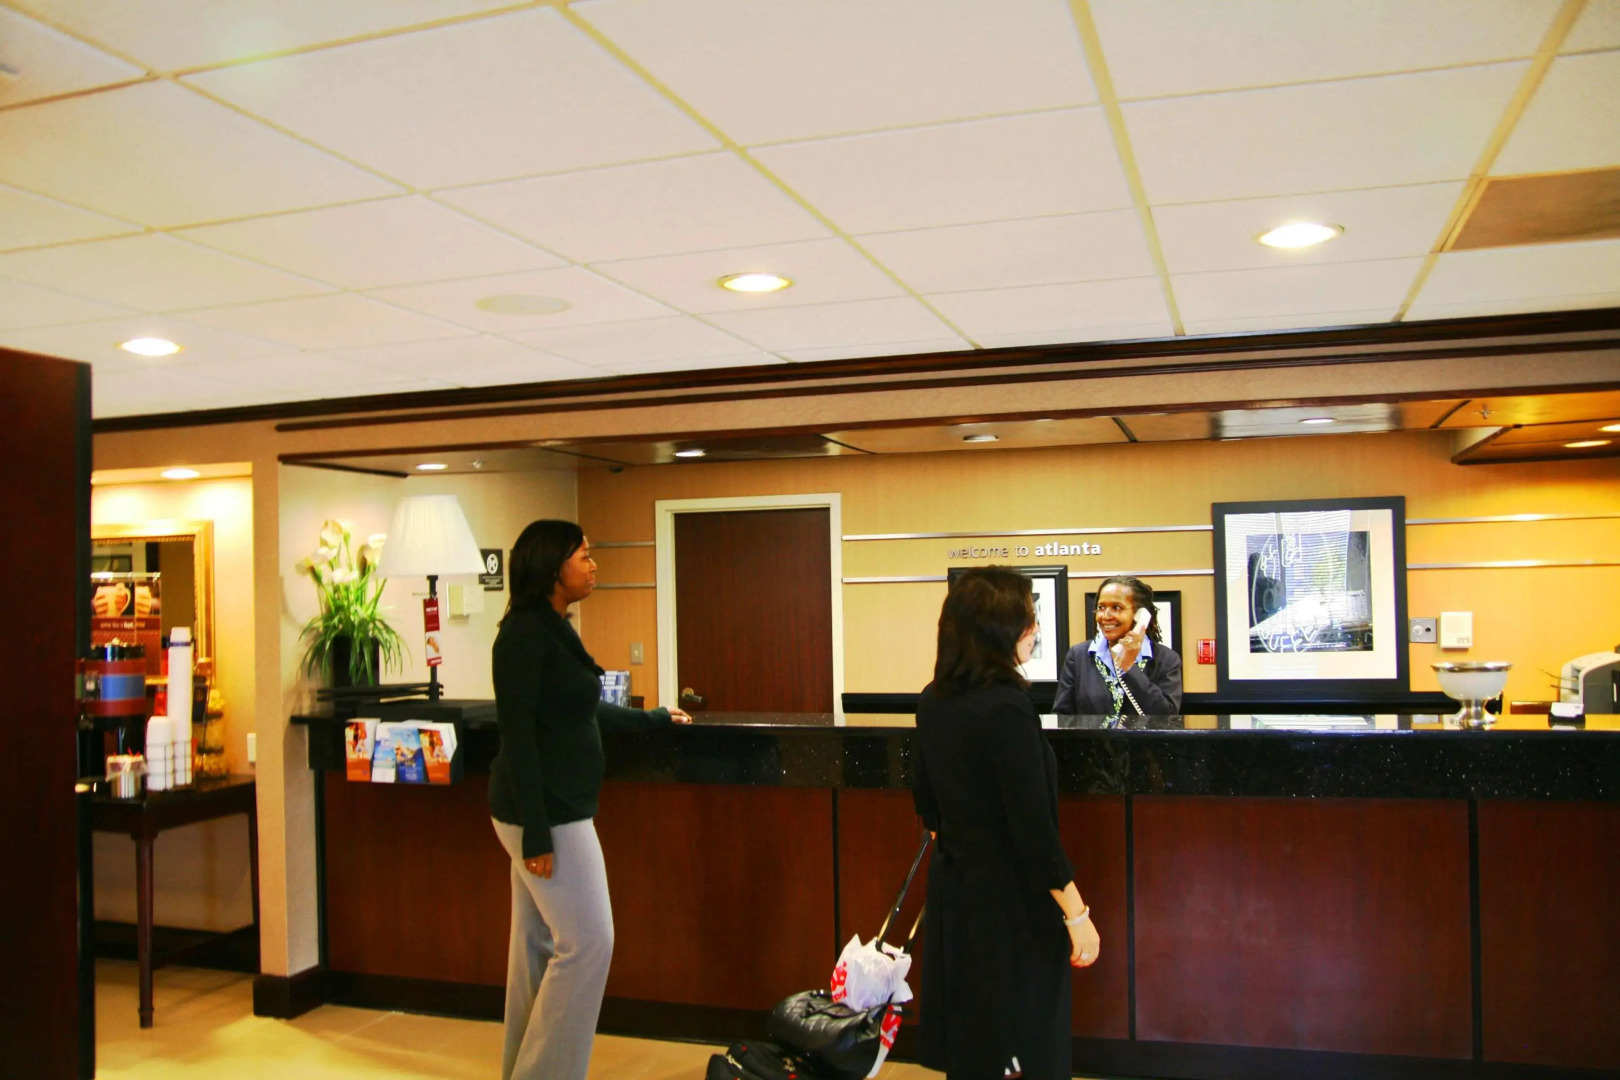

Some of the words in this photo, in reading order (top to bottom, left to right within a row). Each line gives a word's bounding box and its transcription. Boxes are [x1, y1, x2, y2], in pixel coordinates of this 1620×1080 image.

[948, 545, 1009, 559] welcome
[1014, 545, 1029, 557] to
[1034, 541, 1102, 556] atlanta
